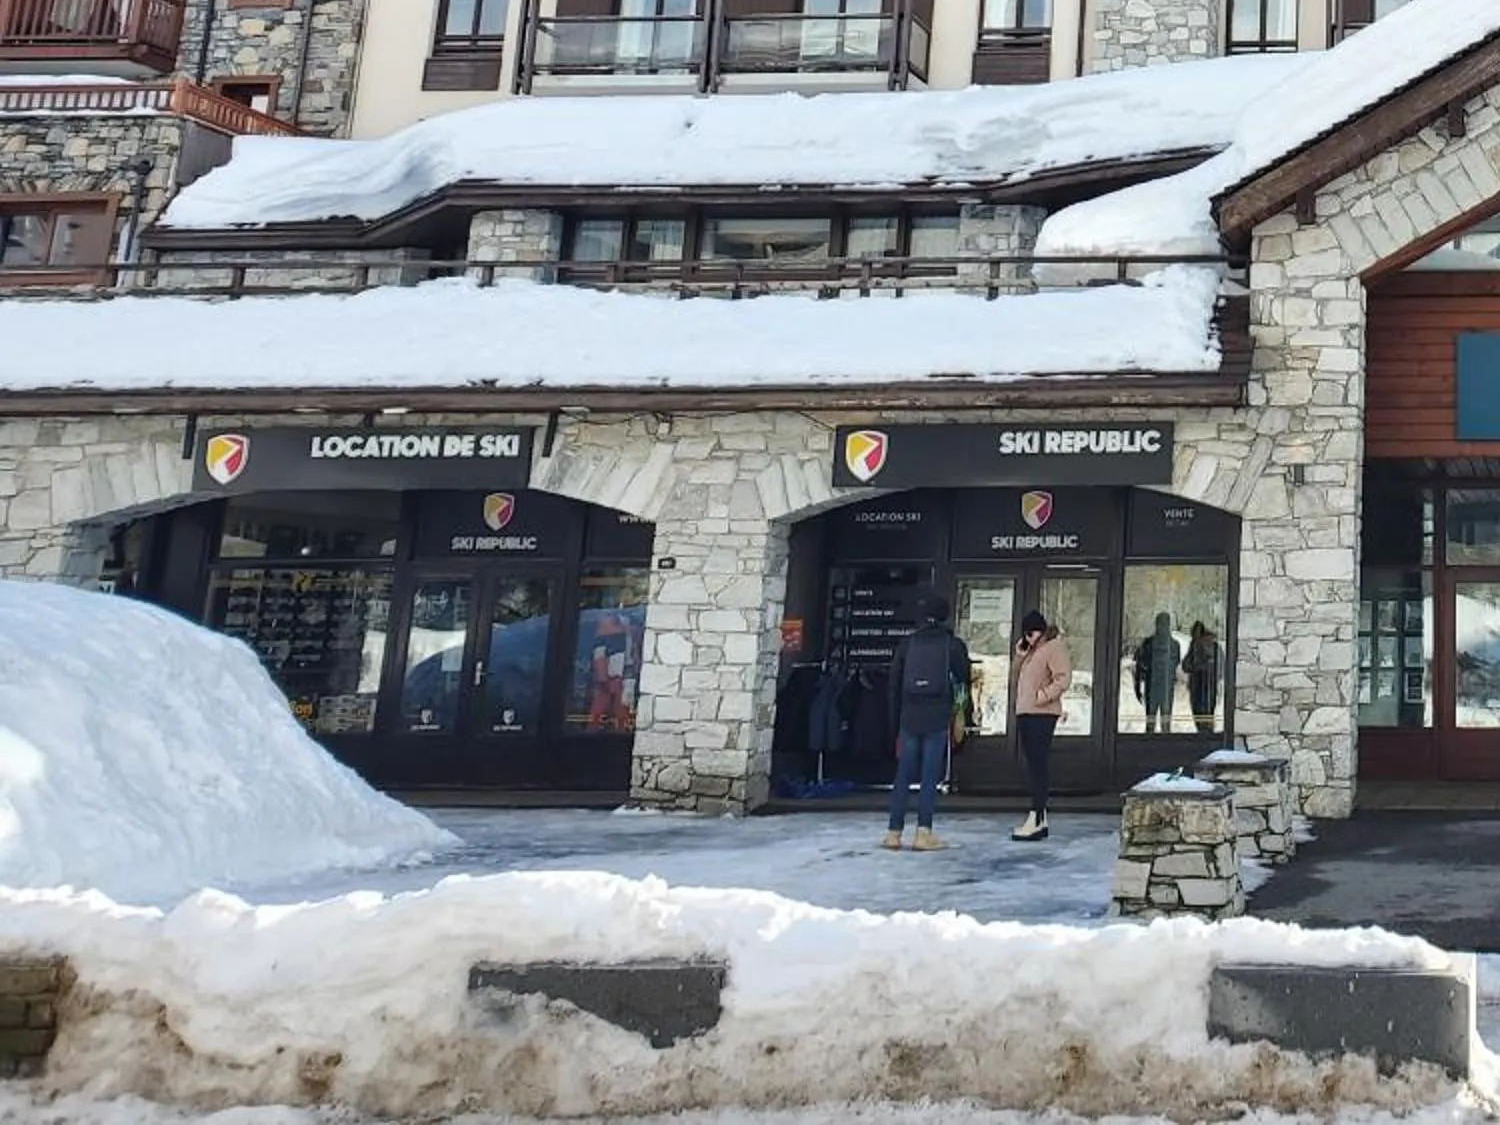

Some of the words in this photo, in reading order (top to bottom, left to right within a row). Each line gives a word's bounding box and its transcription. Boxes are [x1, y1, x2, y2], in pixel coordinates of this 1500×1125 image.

[311, 435, 441, 458] LOCATION
[443, 435, 477, 457] DE
[480, 434, 520, 457] SKI
[999, 431, 1039, 454] SKI
[1044, 430, 1161, 453] REPUBLIC
[451, 536, 473, 551] SKI
[475, 536, 537, 551] REPUBLIC
[991, 536, 1014, 549] SKI
[1015, 535, 1079, 549] REPUBLIC
